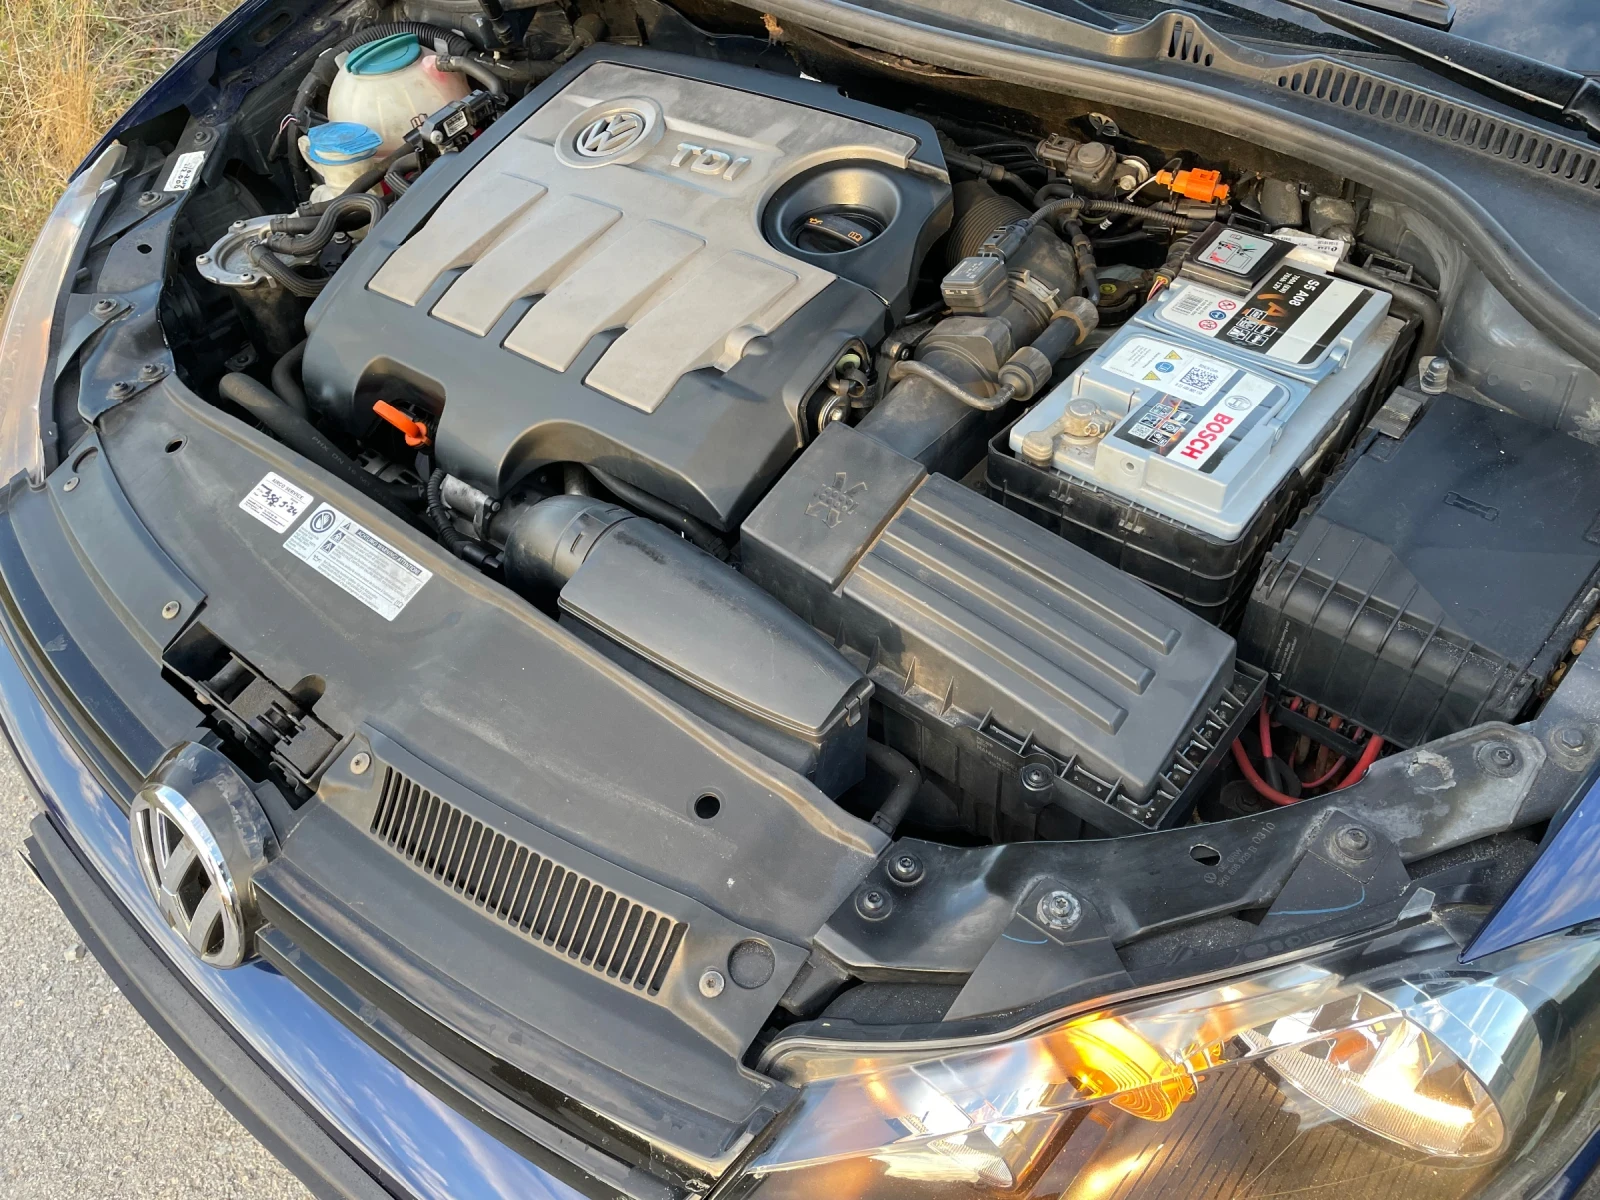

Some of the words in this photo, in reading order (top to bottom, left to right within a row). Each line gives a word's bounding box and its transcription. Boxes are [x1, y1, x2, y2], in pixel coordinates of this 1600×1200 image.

[670, 143, 751, 181] TDI
[1303, 279, 1320, 291] S5
[1288, 290, 1310, 307] A08
[1180, 412, 1234, 460] BOSCH
[272, 478, 286, 489] AIRCO
[285, 486, 305, 501] SERVICE
[1251, 822, 1276, 844] 0310
